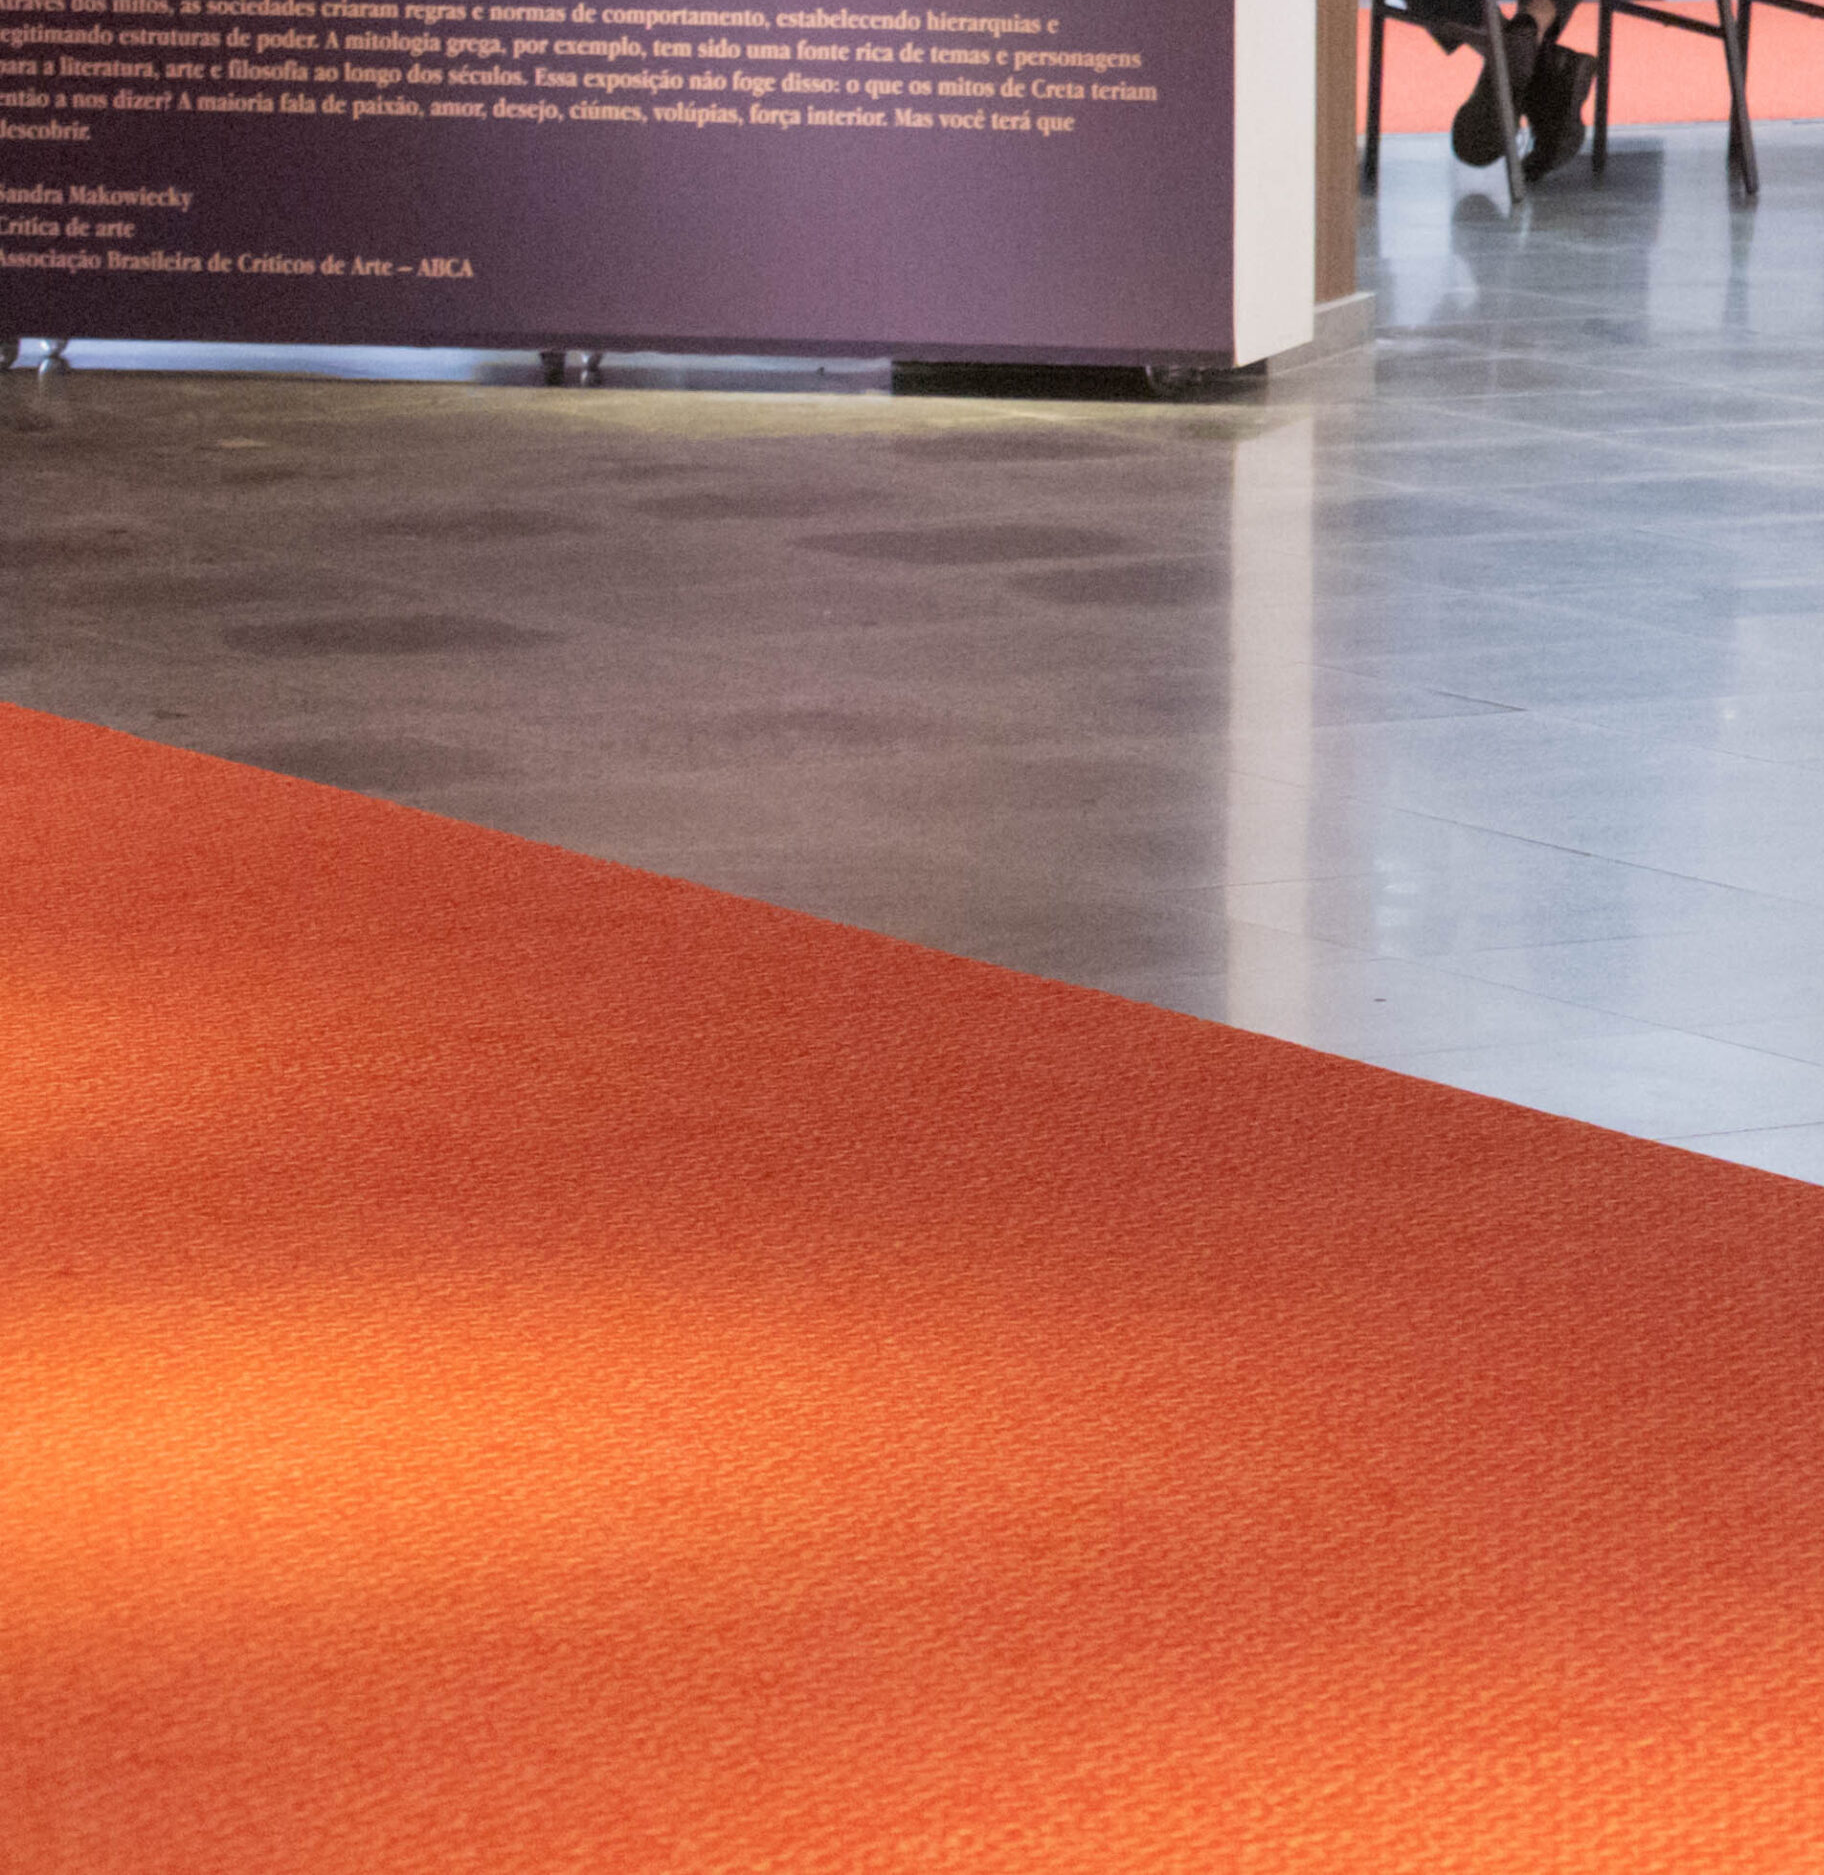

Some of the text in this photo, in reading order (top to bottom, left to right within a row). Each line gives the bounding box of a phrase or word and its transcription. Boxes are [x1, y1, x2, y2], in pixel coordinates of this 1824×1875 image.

[404, 2, 467, 25] regras
[471, 4, 483, 20] e
[489, 4, 566, 22] normas
[571, 2, 596, 22] de
[601, 7, 772, 31] comportamento,
[926, 10, 1042, 38] hierarquias
[1046, 17, 1059, 34] e
[69, 183, 193, 212] Makowiecky
[65, 217, 89, 236] de
[96, 220, 134, 237] arte
[107, 249, 203, 272] Brasileira
[206, 250, 232, 273] de
[319, 253, 346, 276] de
[352, 255, 393, 276] Arte
[418, 256, 474, 278] ABCA
